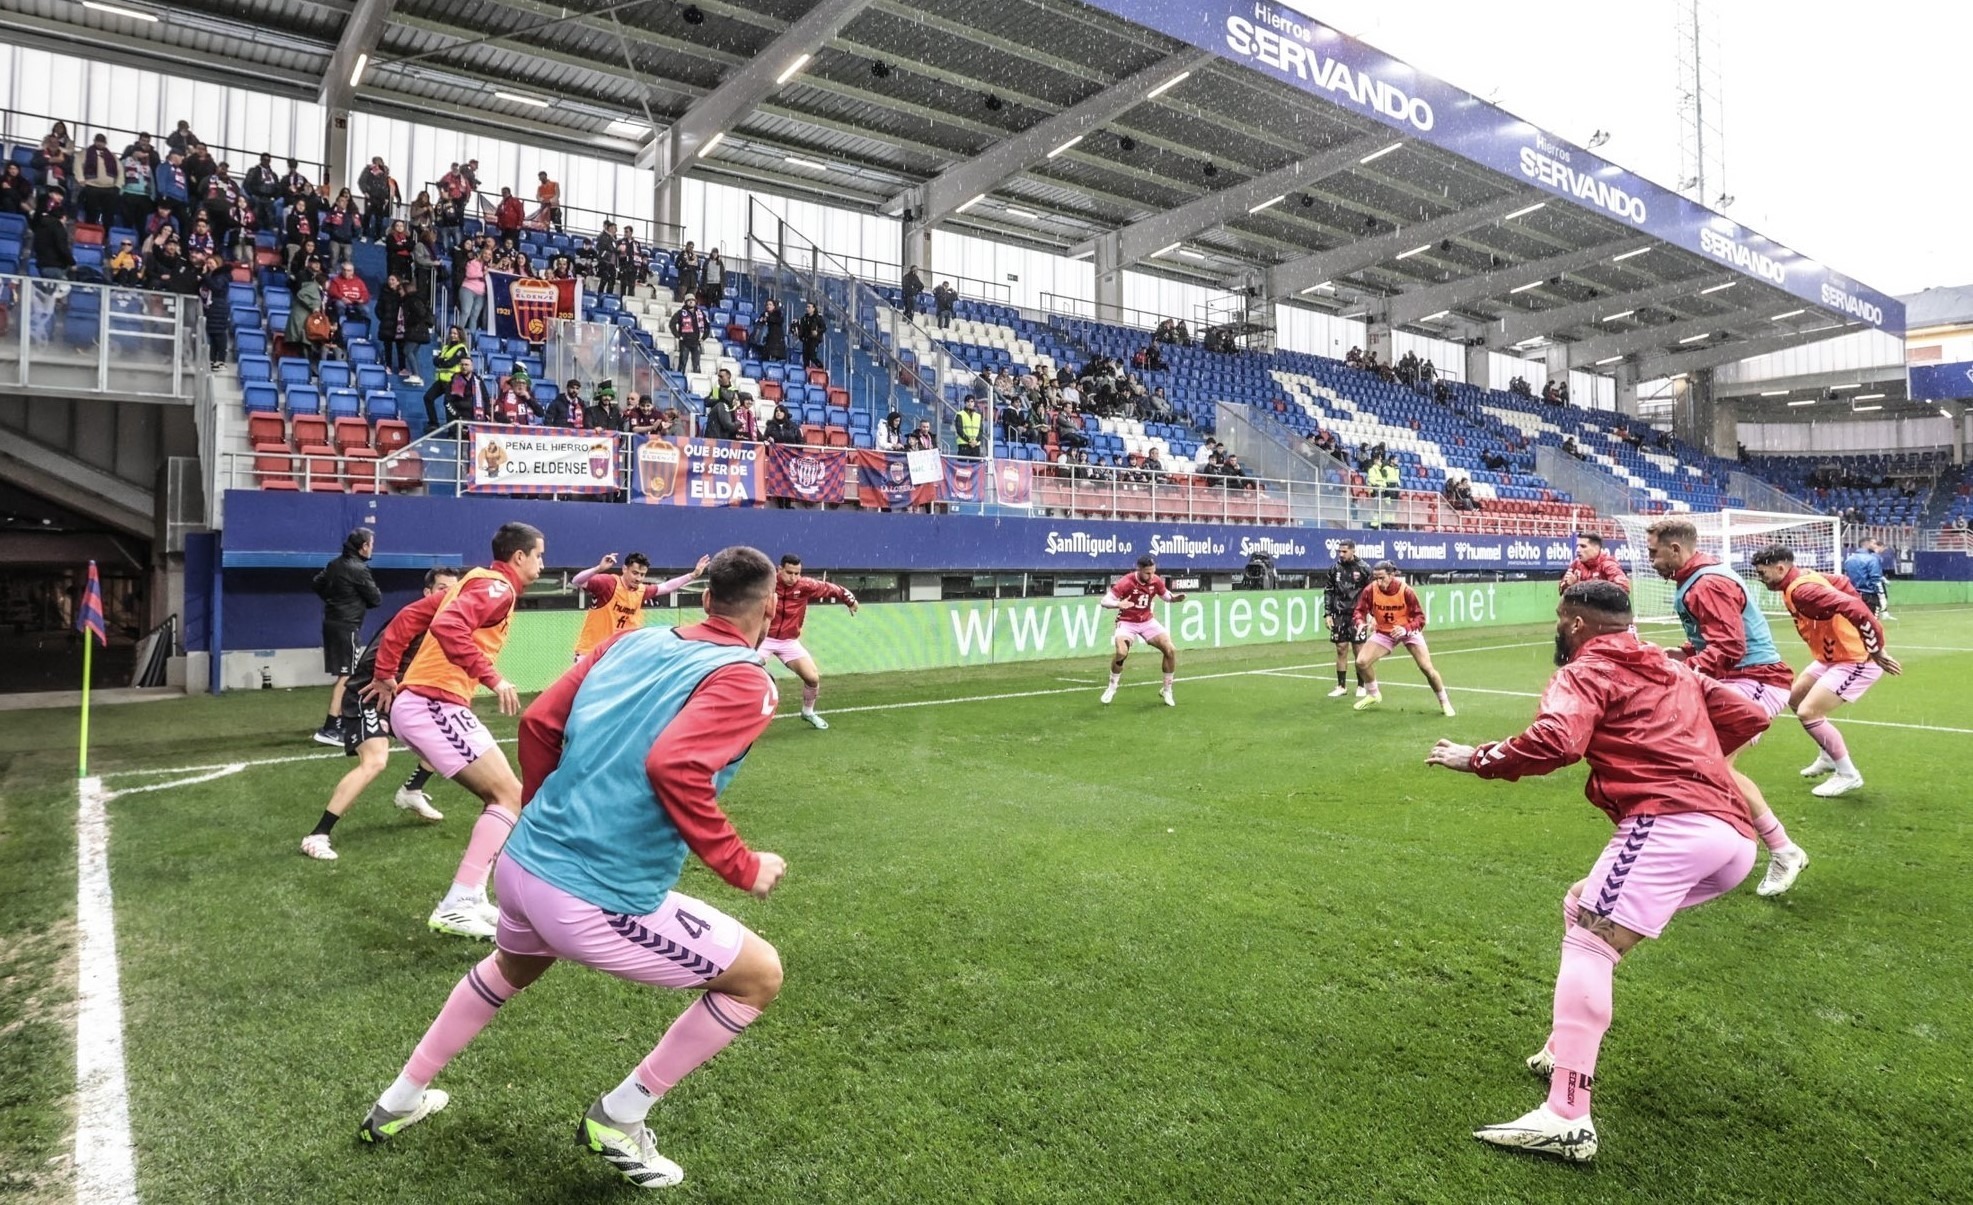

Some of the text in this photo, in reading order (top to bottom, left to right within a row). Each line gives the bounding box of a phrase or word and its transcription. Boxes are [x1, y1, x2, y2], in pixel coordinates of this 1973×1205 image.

[1254, 2, 1312, 43] Hierros
[1226, 15, 1435, 132] SERVANDO
[1536, 133, 1571, 162] Hierros
[1519, 146, 1646, 224] SERVANDO
[1701, 228, 1785, 284] SERVANDO
[1821, 283, 1883, 326] SERVANDO
[505, 440, 589, 452] PEÑA EL HIERRO
[684, 444, 709, 457] QUE
[712, 447, 757, 460] BONITO
[506, 461, 588, 475] C.D. ELDENSE
[693, 462, 748, 476] ES SER DE
[690, 480, 749, 499] ELDA
[1118, 542, 1132, 555] 0,0
[1212, 543, 1225, 555] 0,0
[1294, 545, 1306, 557] 0,0
[1407, 542, 1446, 560] hummel
[1466, 544, 1502, 560] hummel
[1507, 541, 1541, 560] eibho
[1546, 542, 1572, 560] eibh
[675, 908, 711, 939] 4
